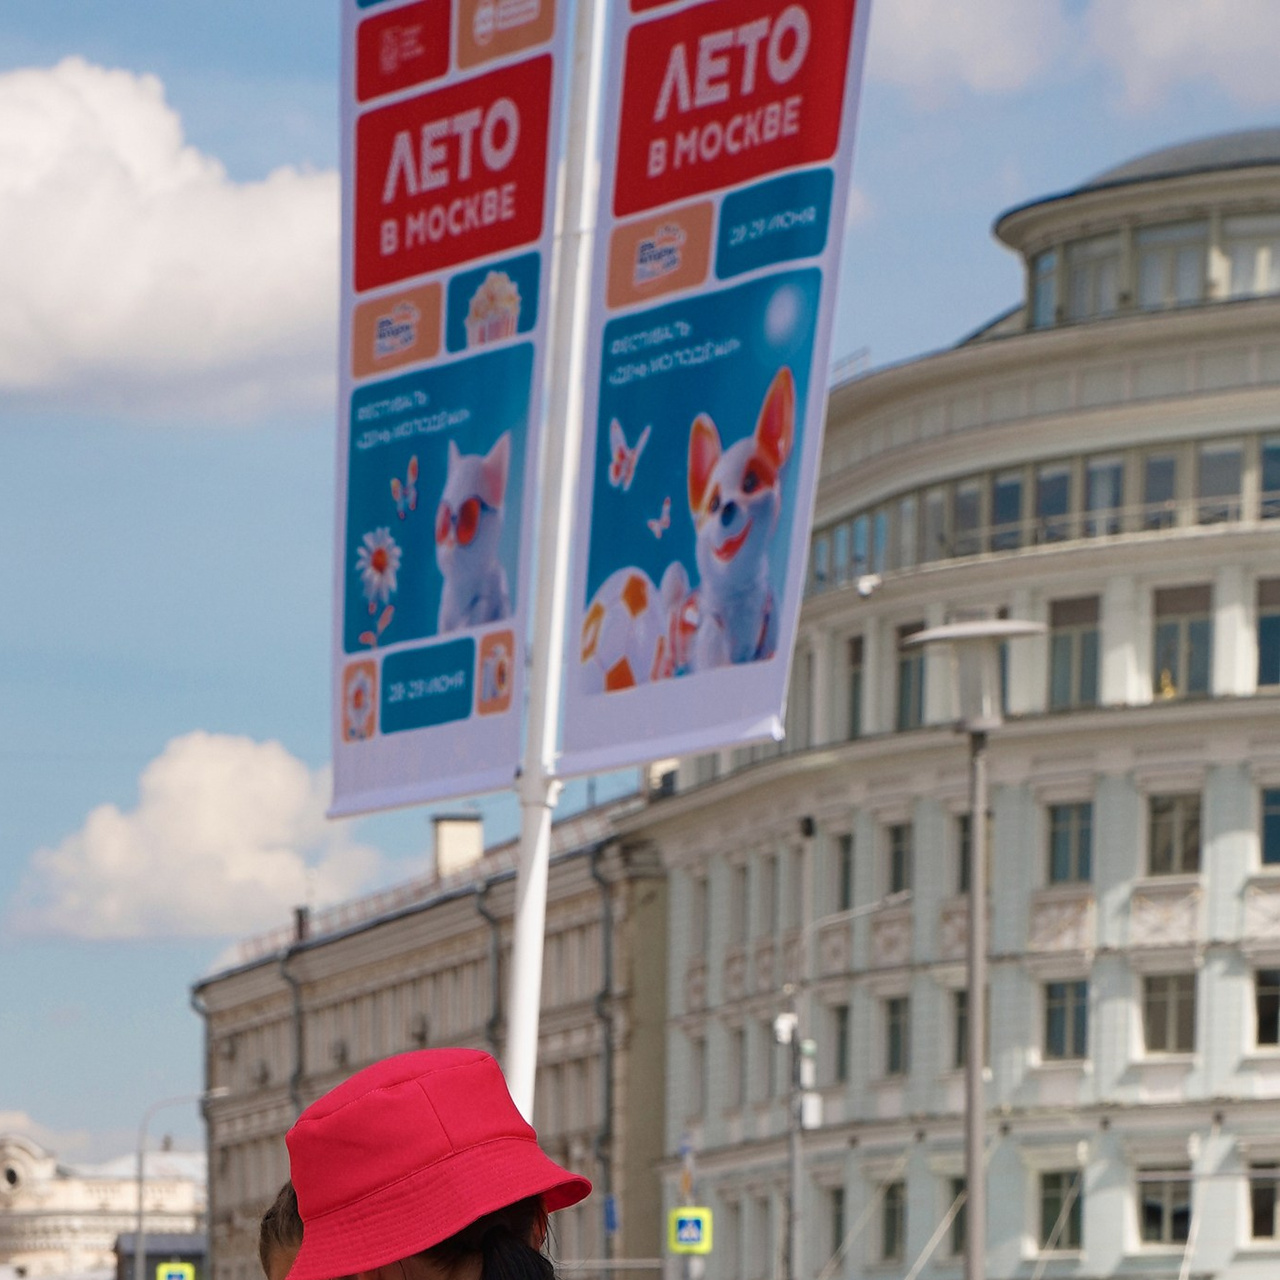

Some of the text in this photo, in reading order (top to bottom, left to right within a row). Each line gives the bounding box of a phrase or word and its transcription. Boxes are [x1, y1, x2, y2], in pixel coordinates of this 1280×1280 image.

[652, 4, 811, 122] ЛЕТО
[382, 97, 520, 204] ЛЕТО
[647, 95, 803, 179] В МОСКВЕ
[380, 183, 517, 256] В МОСКВЕ
